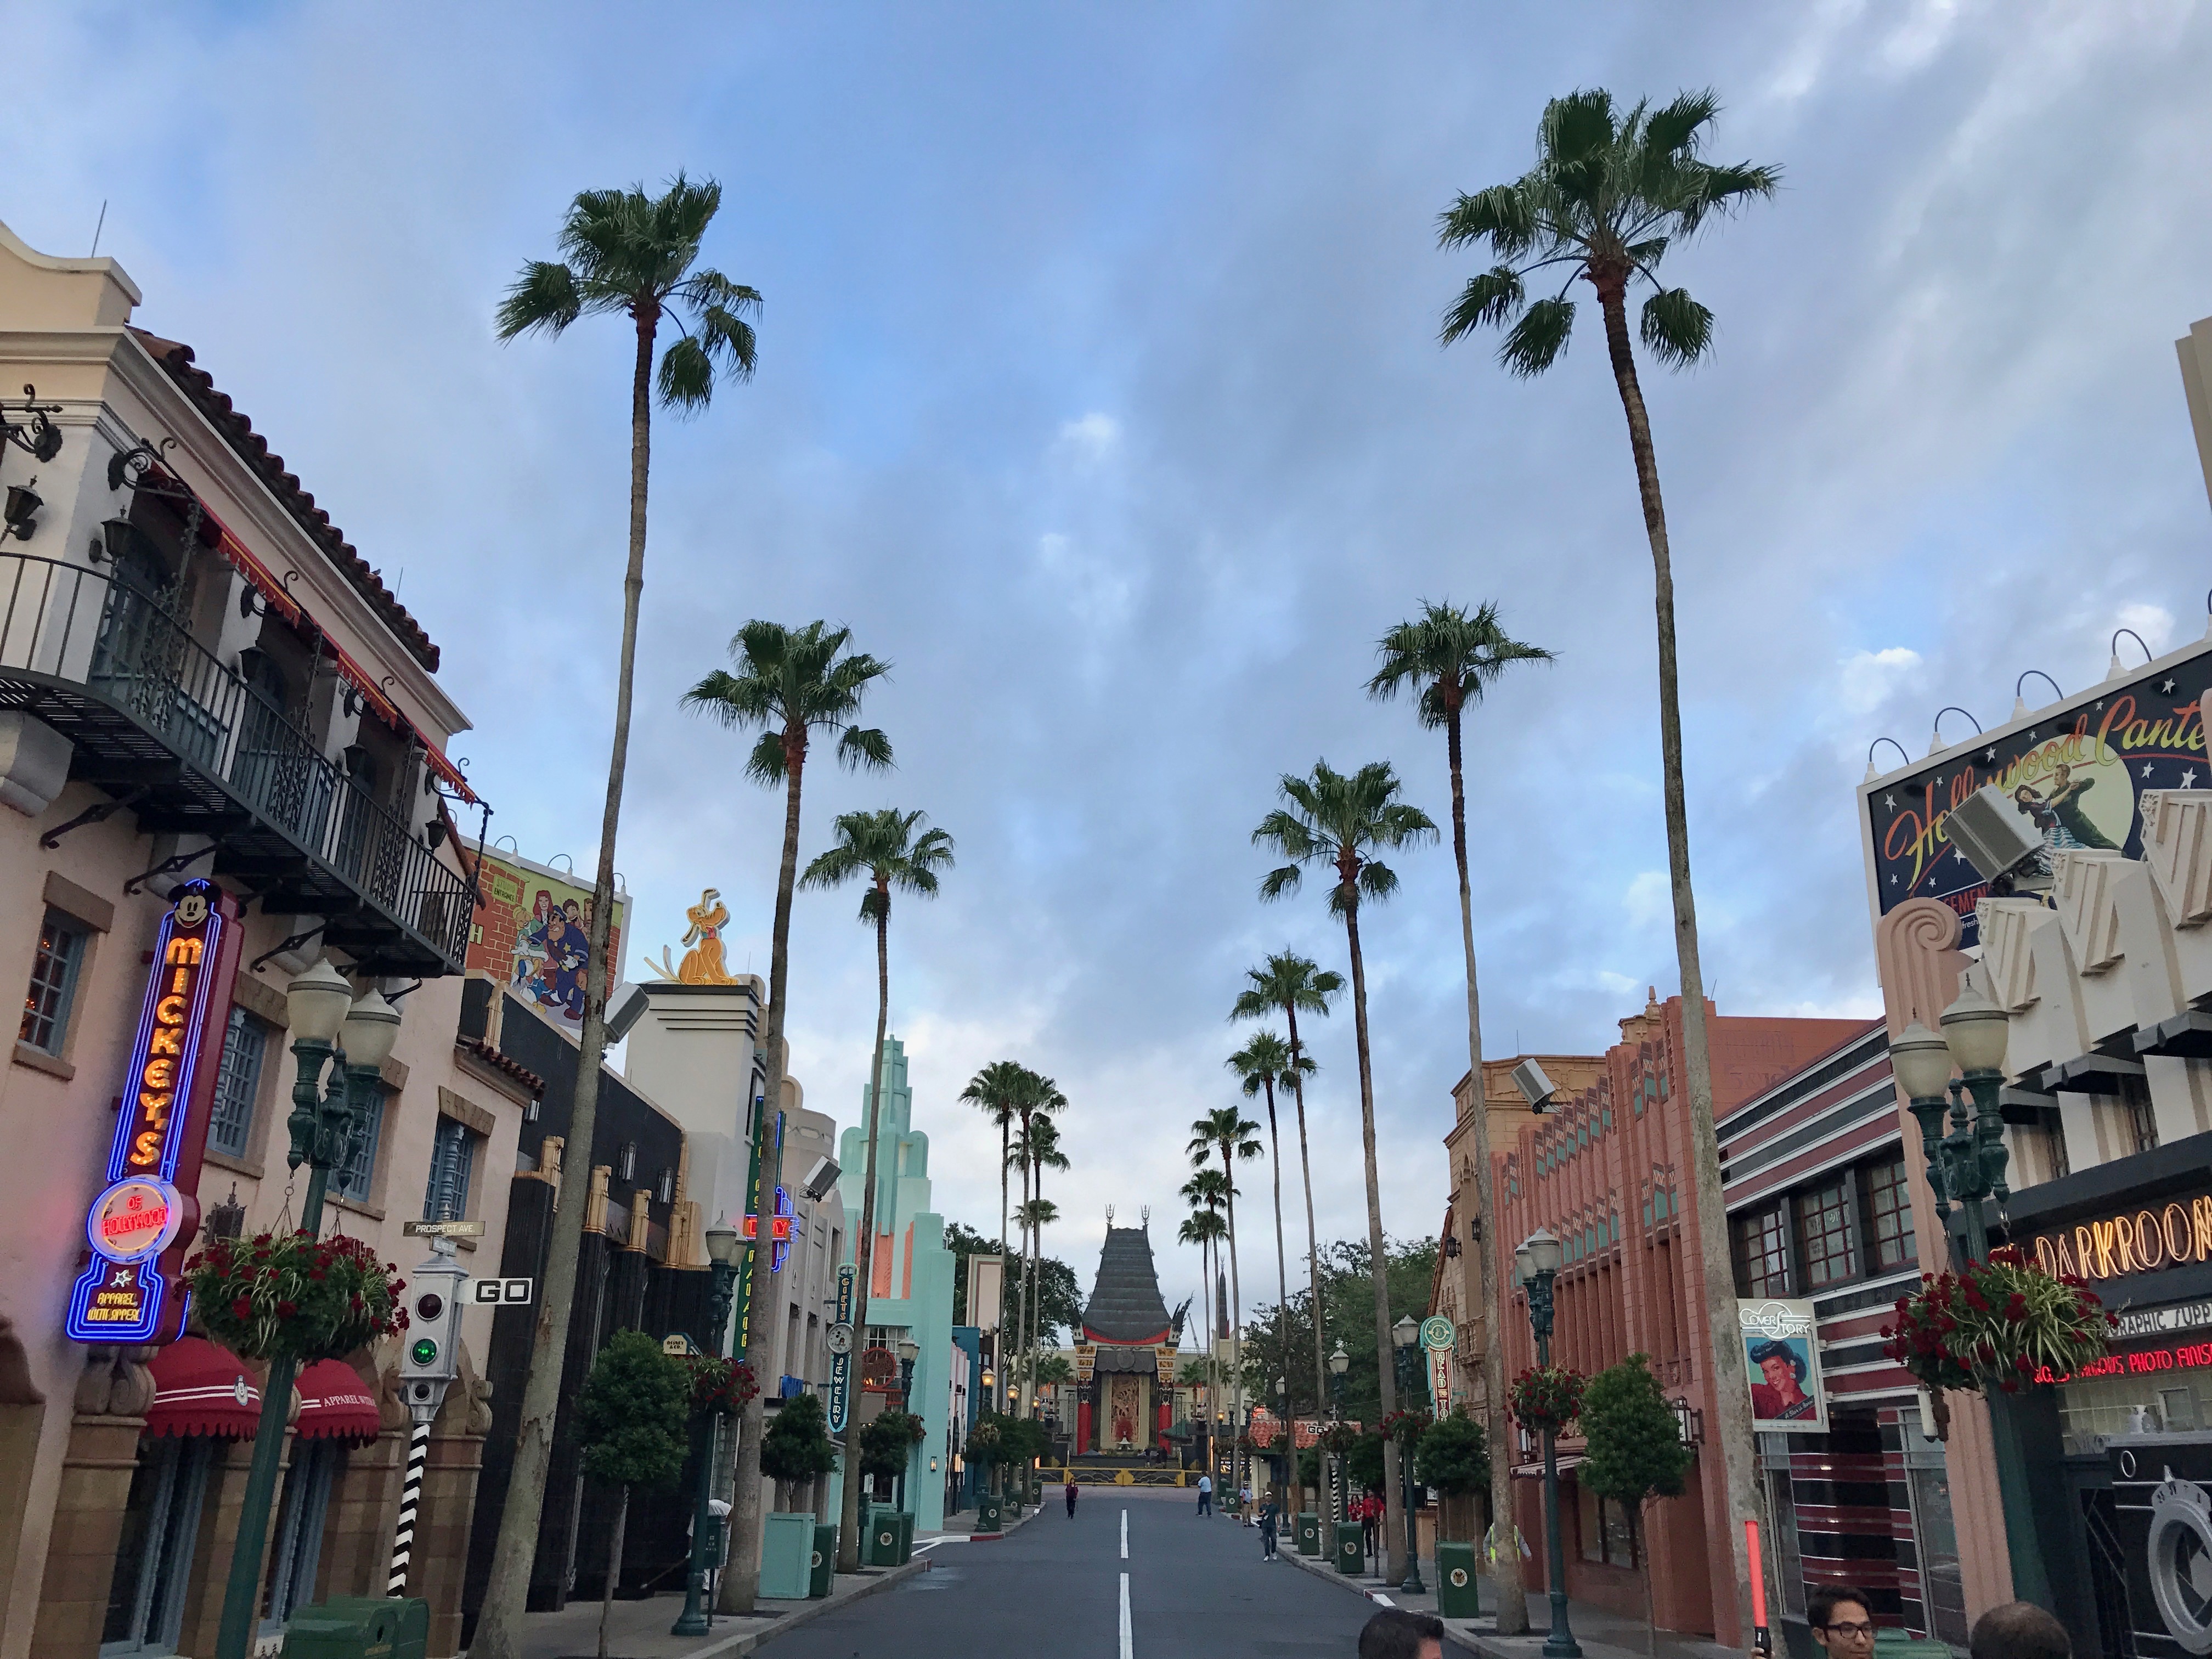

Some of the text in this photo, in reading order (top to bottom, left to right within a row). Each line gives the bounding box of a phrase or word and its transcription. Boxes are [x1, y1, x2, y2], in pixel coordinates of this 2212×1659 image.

[1885, 713, 2088, 890] Hollwood
[494, 887, 515, 902] ENTRANCE
[130, 937, 204, 1166] MICKEY'S
[127, 1195, 143, 1209] OF
[102, 1207, 167, 1235] HOLLYWOOD
[415, 1224, 475, 1233] PROSPECT AVE.
[748, 1220, 788, 1235] TY
[97, 1293, 136, 1305] APPAREL
[476, 1279, 530, 1303] GO
[839, 1278, 850, 1321] GIFTS
[109, 1308, 141, 1322] APPEAL
[1740, 1308, 1810, 1335] COVER STORY
[1435, 1351, 1447, 1388] HEAD
[2129, 1349, 2173, 1373] PHOTO
[324, 1395, 360, 1407] APPAREL
[833, 1357, 845, 1424] JEWELRY
